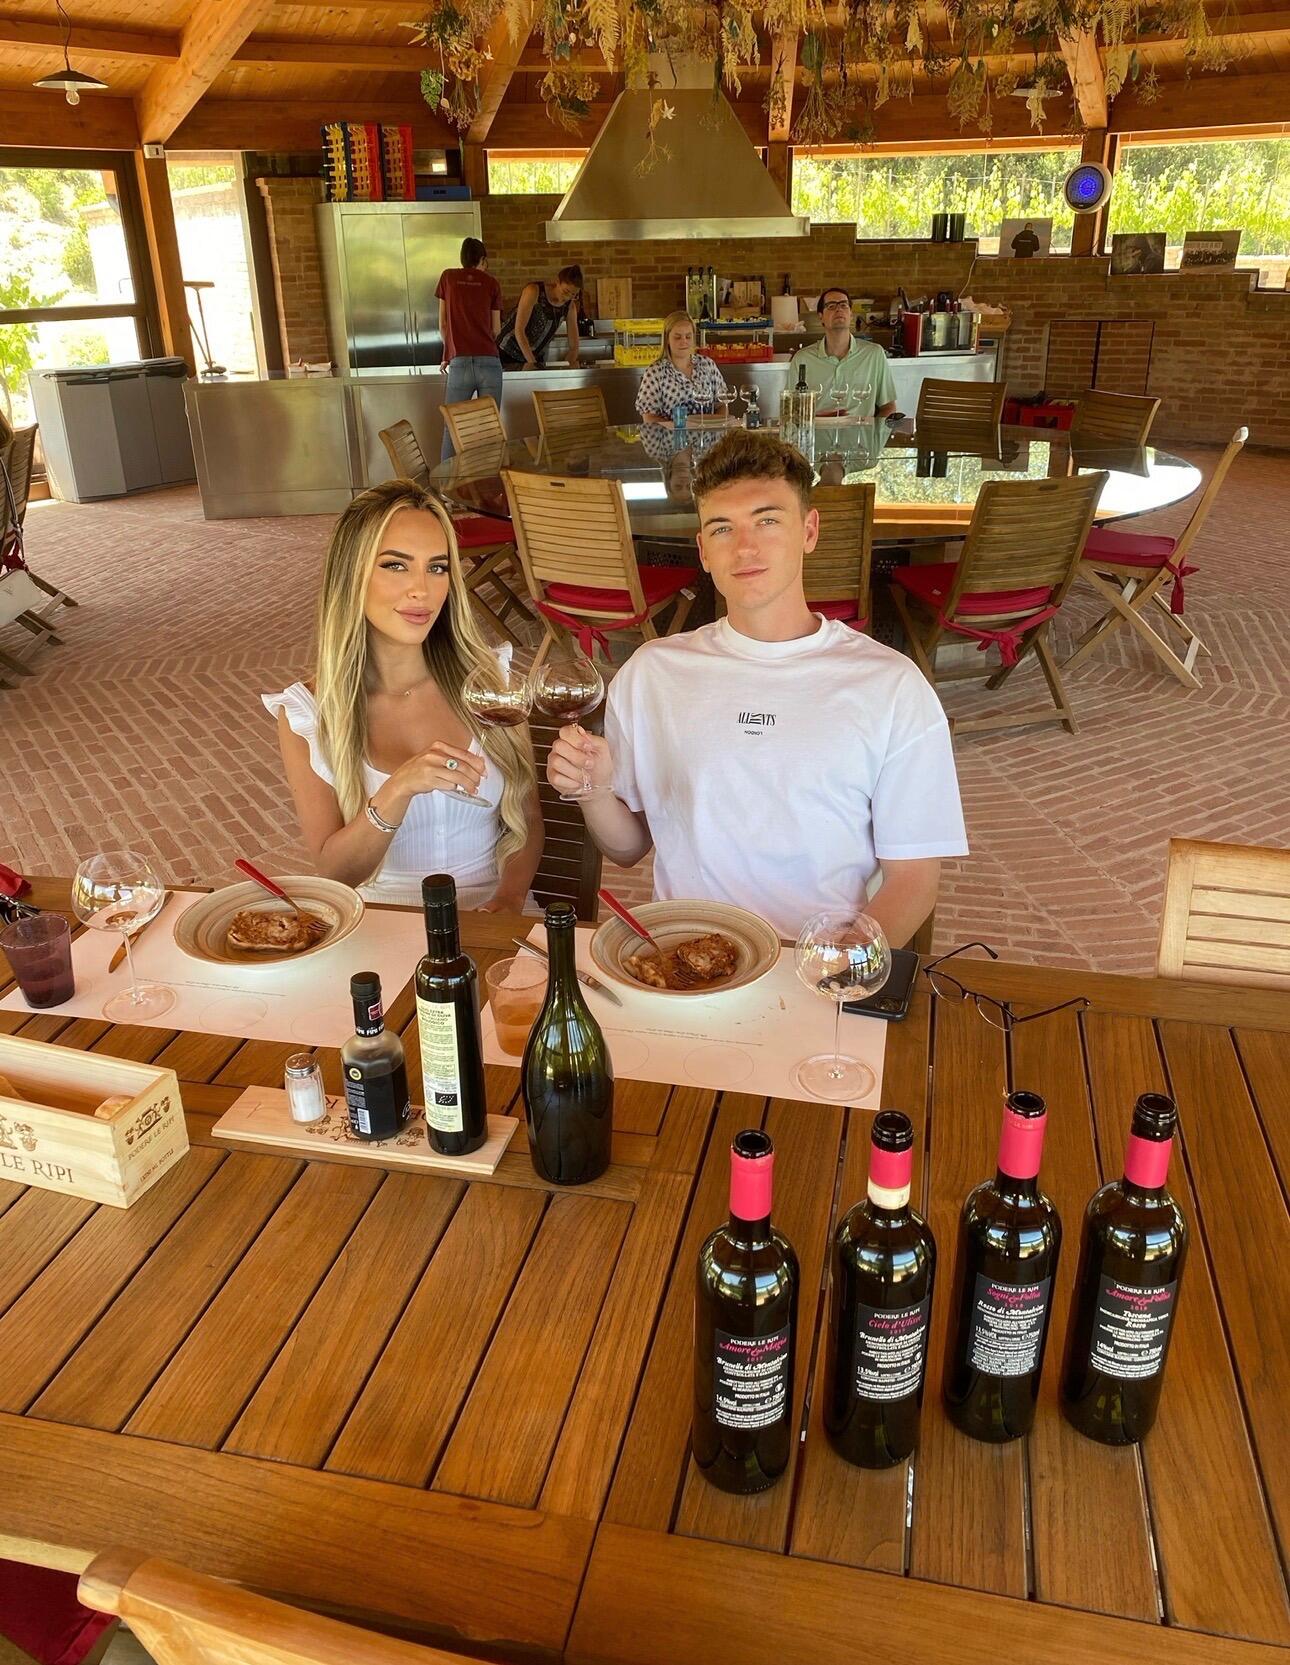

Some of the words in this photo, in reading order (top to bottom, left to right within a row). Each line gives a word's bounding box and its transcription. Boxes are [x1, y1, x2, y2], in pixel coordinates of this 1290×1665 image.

[1, 1153, 25, 1171] LE
[31, 1159, 75, 1183] RIPI
[977, 1300, 996, 1312] Rosso
[997, 1306, 1005, 1314] di
[868, 1319, 890, 1329] Cielo
[859, 1331, 887, 1343] Brunello
[720, 1342, 751, 1354] Amore
[716, 1356, 744, 1370] Brunello
[745, 1363, 752, 1371] di
